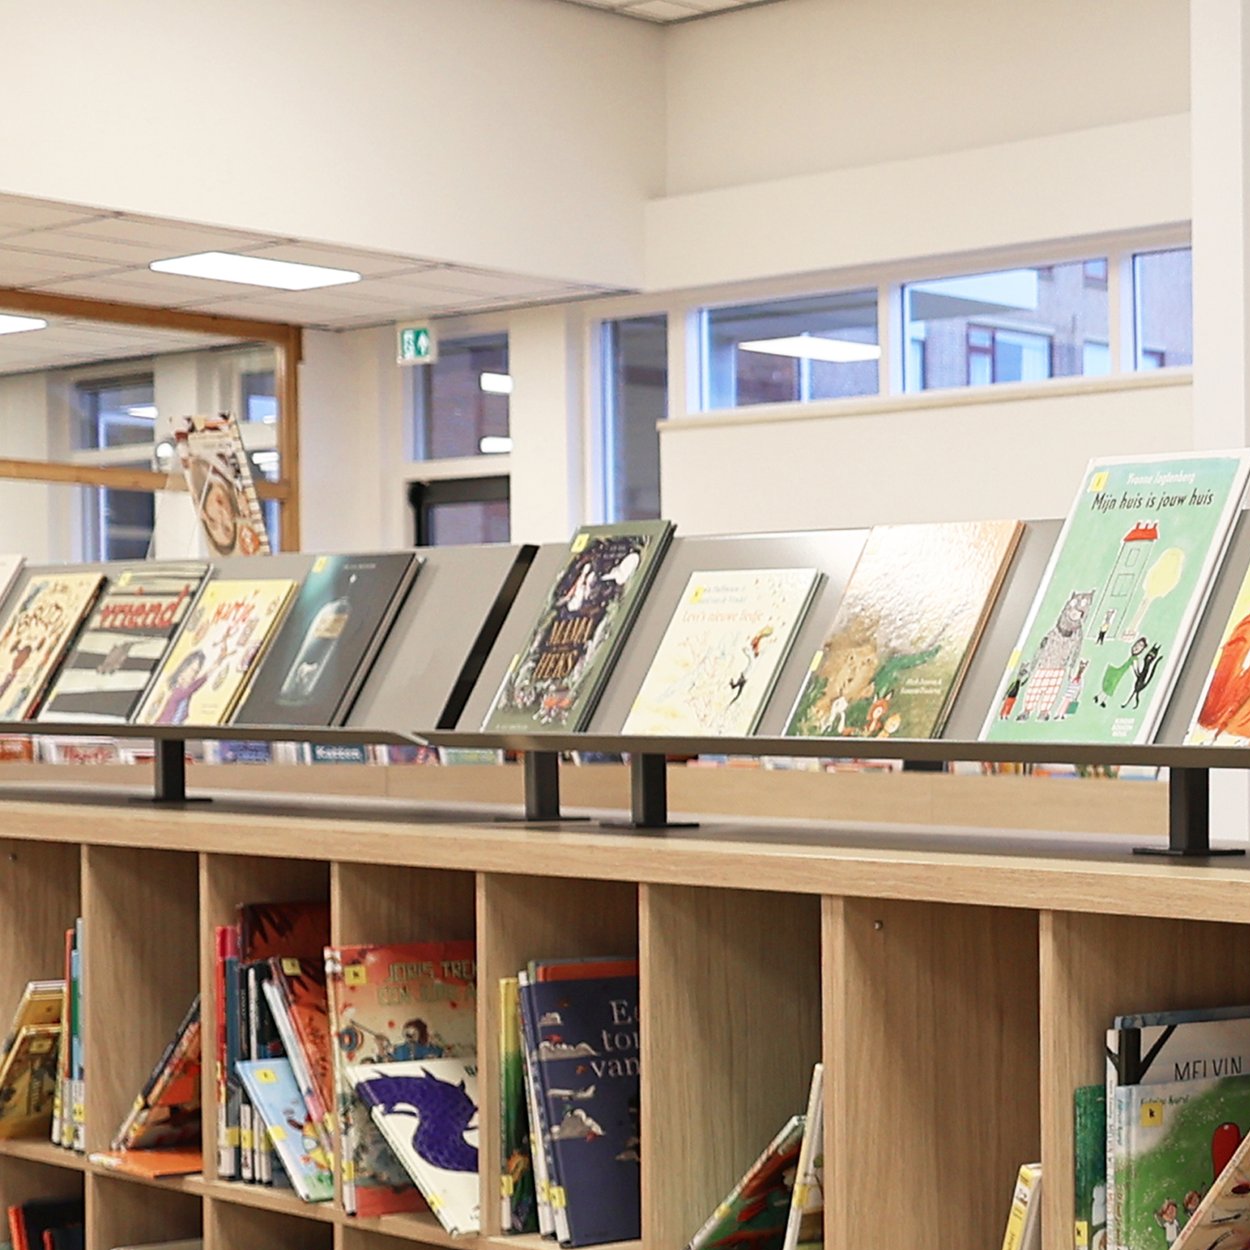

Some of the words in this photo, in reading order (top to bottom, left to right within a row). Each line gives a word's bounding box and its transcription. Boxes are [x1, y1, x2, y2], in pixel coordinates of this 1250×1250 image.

[1091, 493, 1117, 513] Mijn
[1119, 492, 1142, 509] huis
[1145, 494, 1155, 508] is
[1156, 493, 1187, 511] jouw
[1188, 488, 1214, 506] huis
